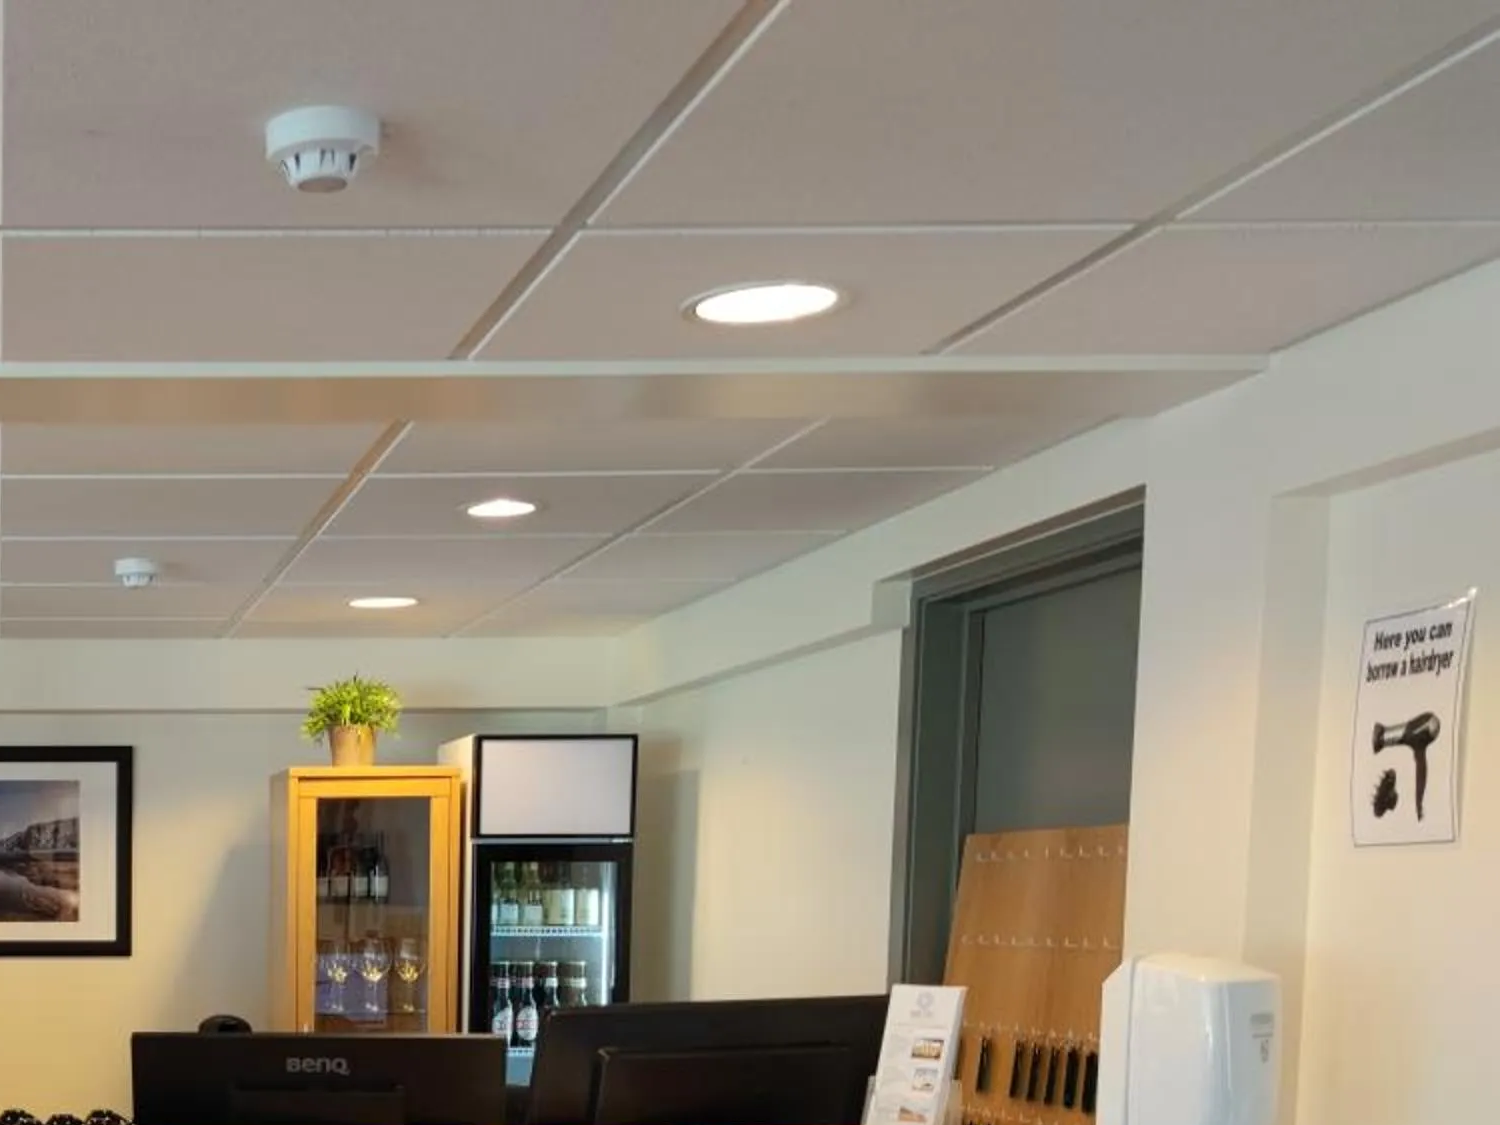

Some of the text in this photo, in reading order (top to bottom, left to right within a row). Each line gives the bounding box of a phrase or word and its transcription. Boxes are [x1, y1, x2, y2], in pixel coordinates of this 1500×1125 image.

[1374, 621, 1453, 651] Here you can
[1366, 648, 1454, 682] borrow a hairdryer
[286, 1057, 351, 1076] BenQ
